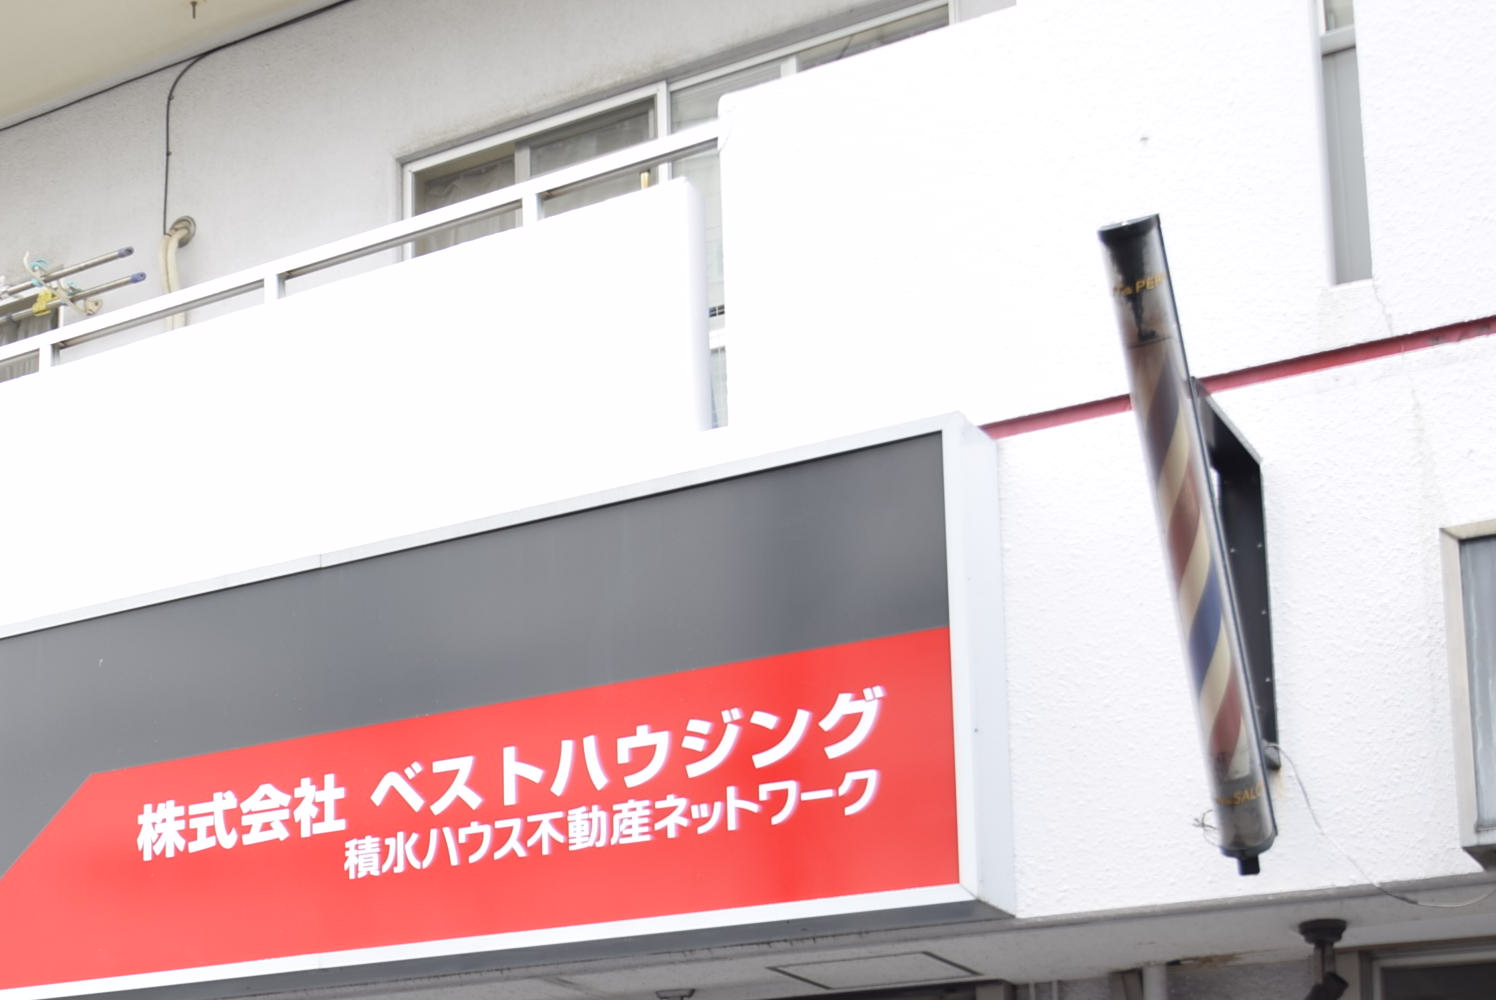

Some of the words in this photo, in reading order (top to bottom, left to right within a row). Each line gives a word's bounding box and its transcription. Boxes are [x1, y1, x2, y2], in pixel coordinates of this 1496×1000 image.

[137, 774, 347, 862] 株式会社
[370, 685, 886, 817] ベストハウジング
[344, 769, 880, 880] 積水ハウス不動産ネットワーク
